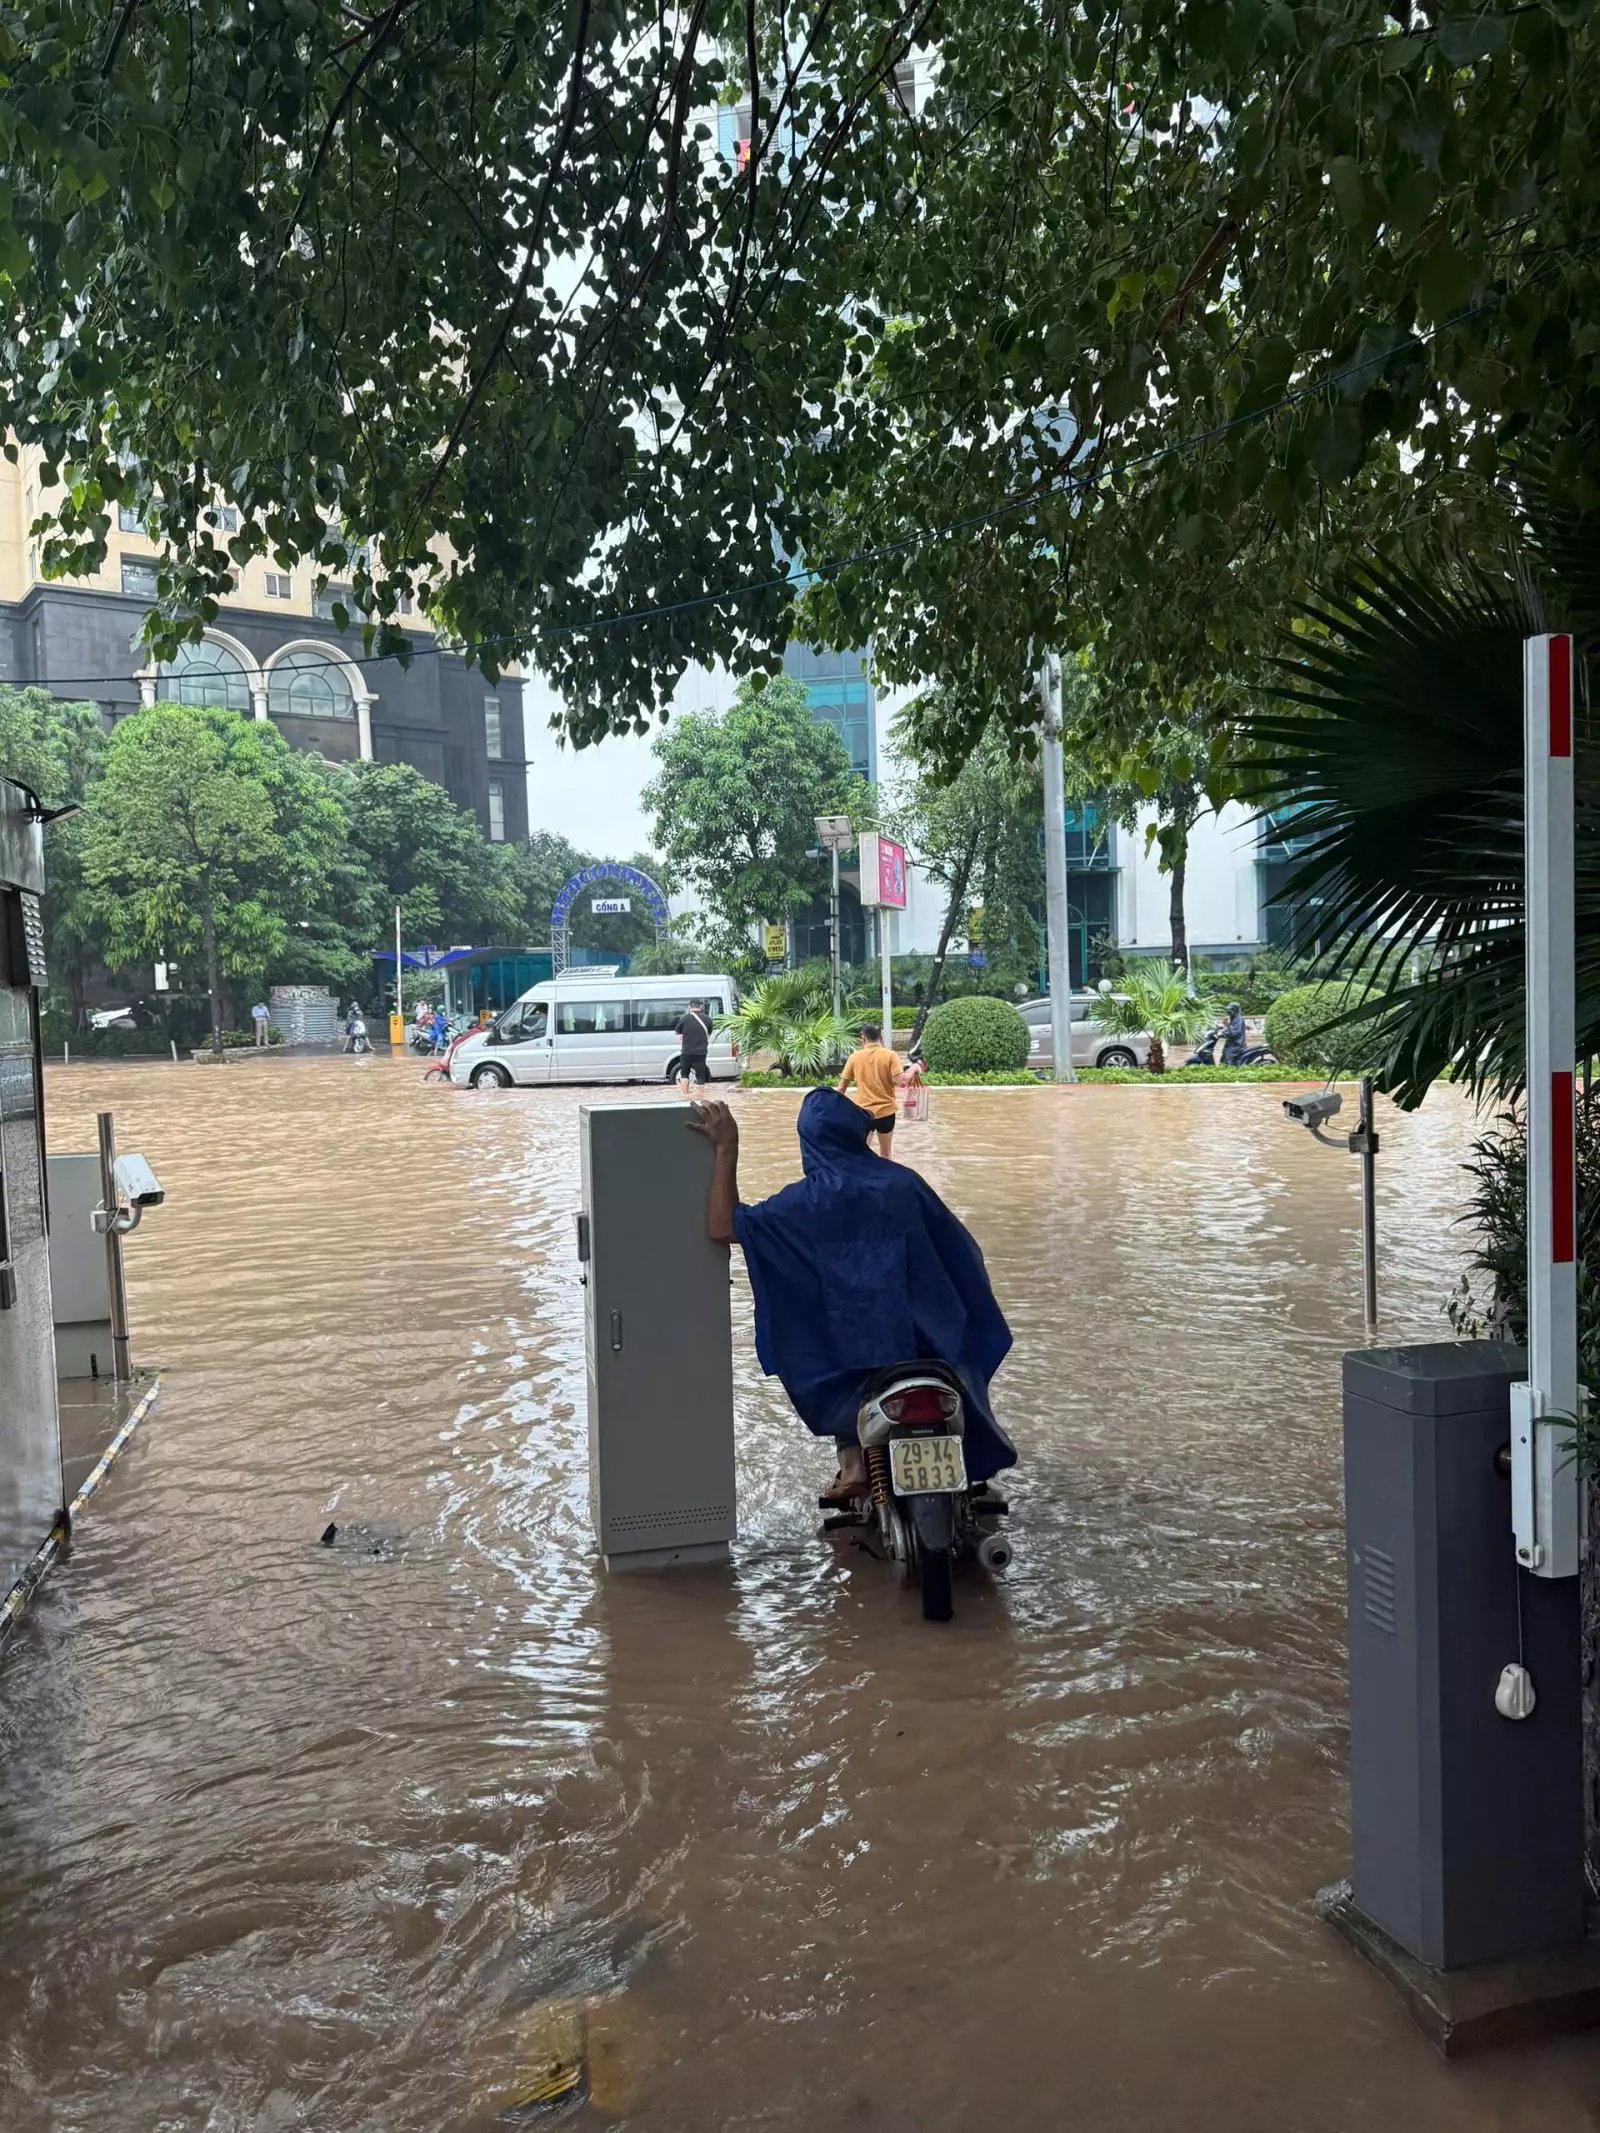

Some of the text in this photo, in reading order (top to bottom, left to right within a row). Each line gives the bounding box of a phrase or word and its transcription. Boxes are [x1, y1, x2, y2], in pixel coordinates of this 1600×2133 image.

[620, 903, 626, 911] A
[901, 1440, 953, 1465] 29-X4
[903, 1464, 957, 1490] 5833
